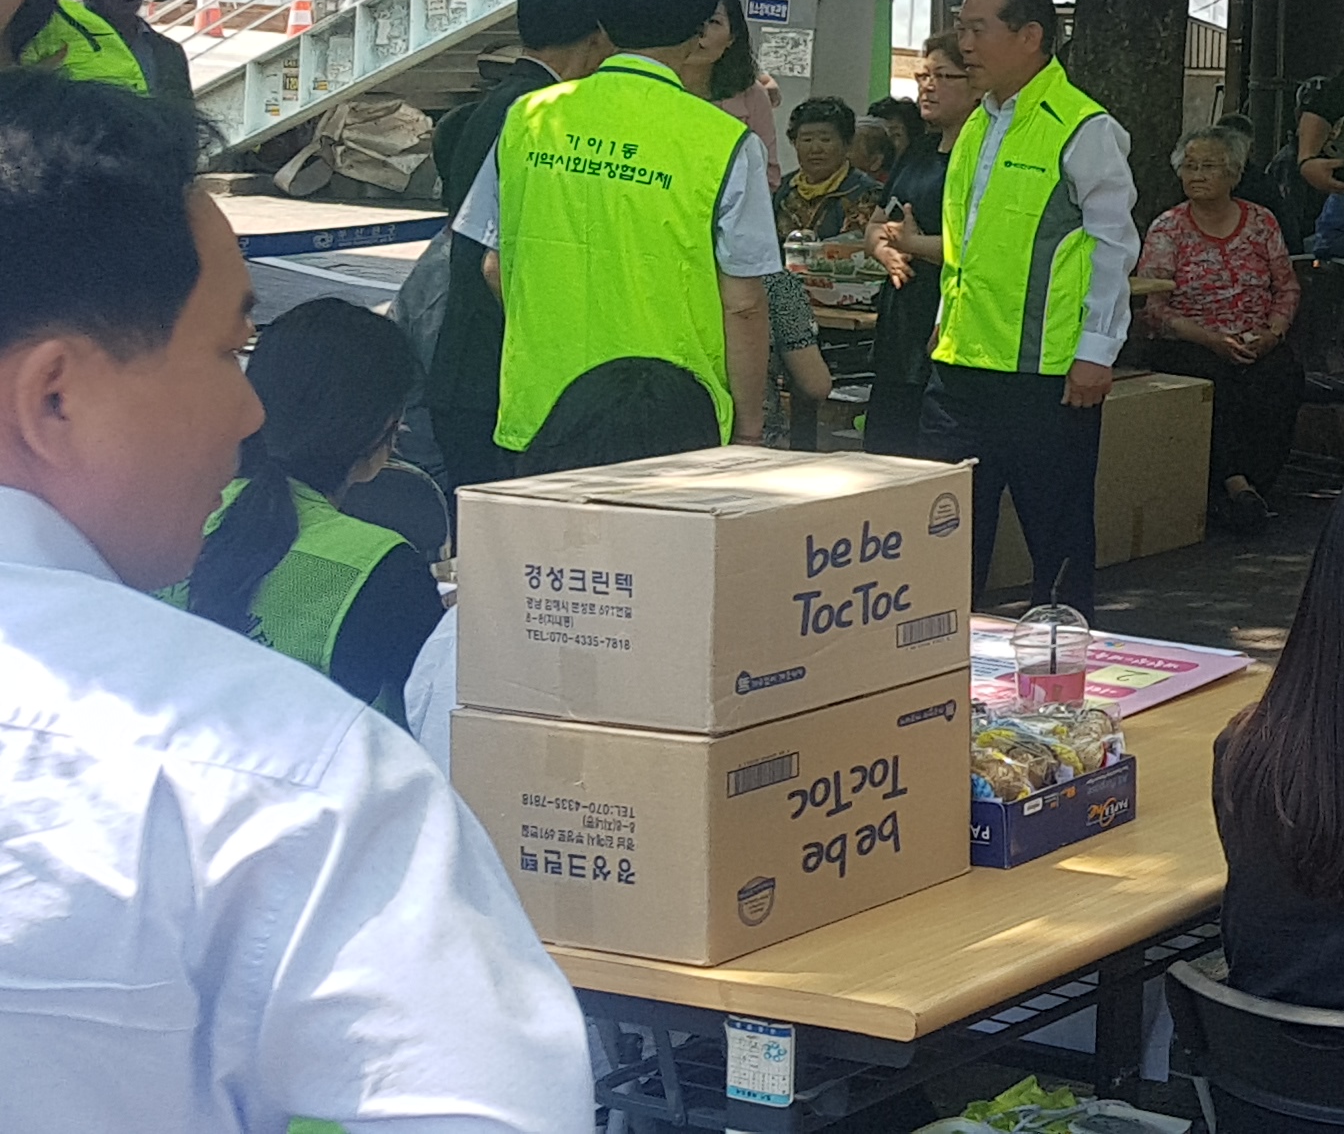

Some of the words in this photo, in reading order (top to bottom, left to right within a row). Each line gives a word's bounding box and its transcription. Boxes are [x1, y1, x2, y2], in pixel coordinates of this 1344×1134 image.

[525, 150, 673, 190] 지역사회보장협의체
[525, 564, 633, 598] 경성크린텍
[525, 628, 632, 651] TEL:070-4335-7818
[522, 793, 636, 819] TEL:070-4335-7818
[520, 845, 636, 885] 경성크린텍
